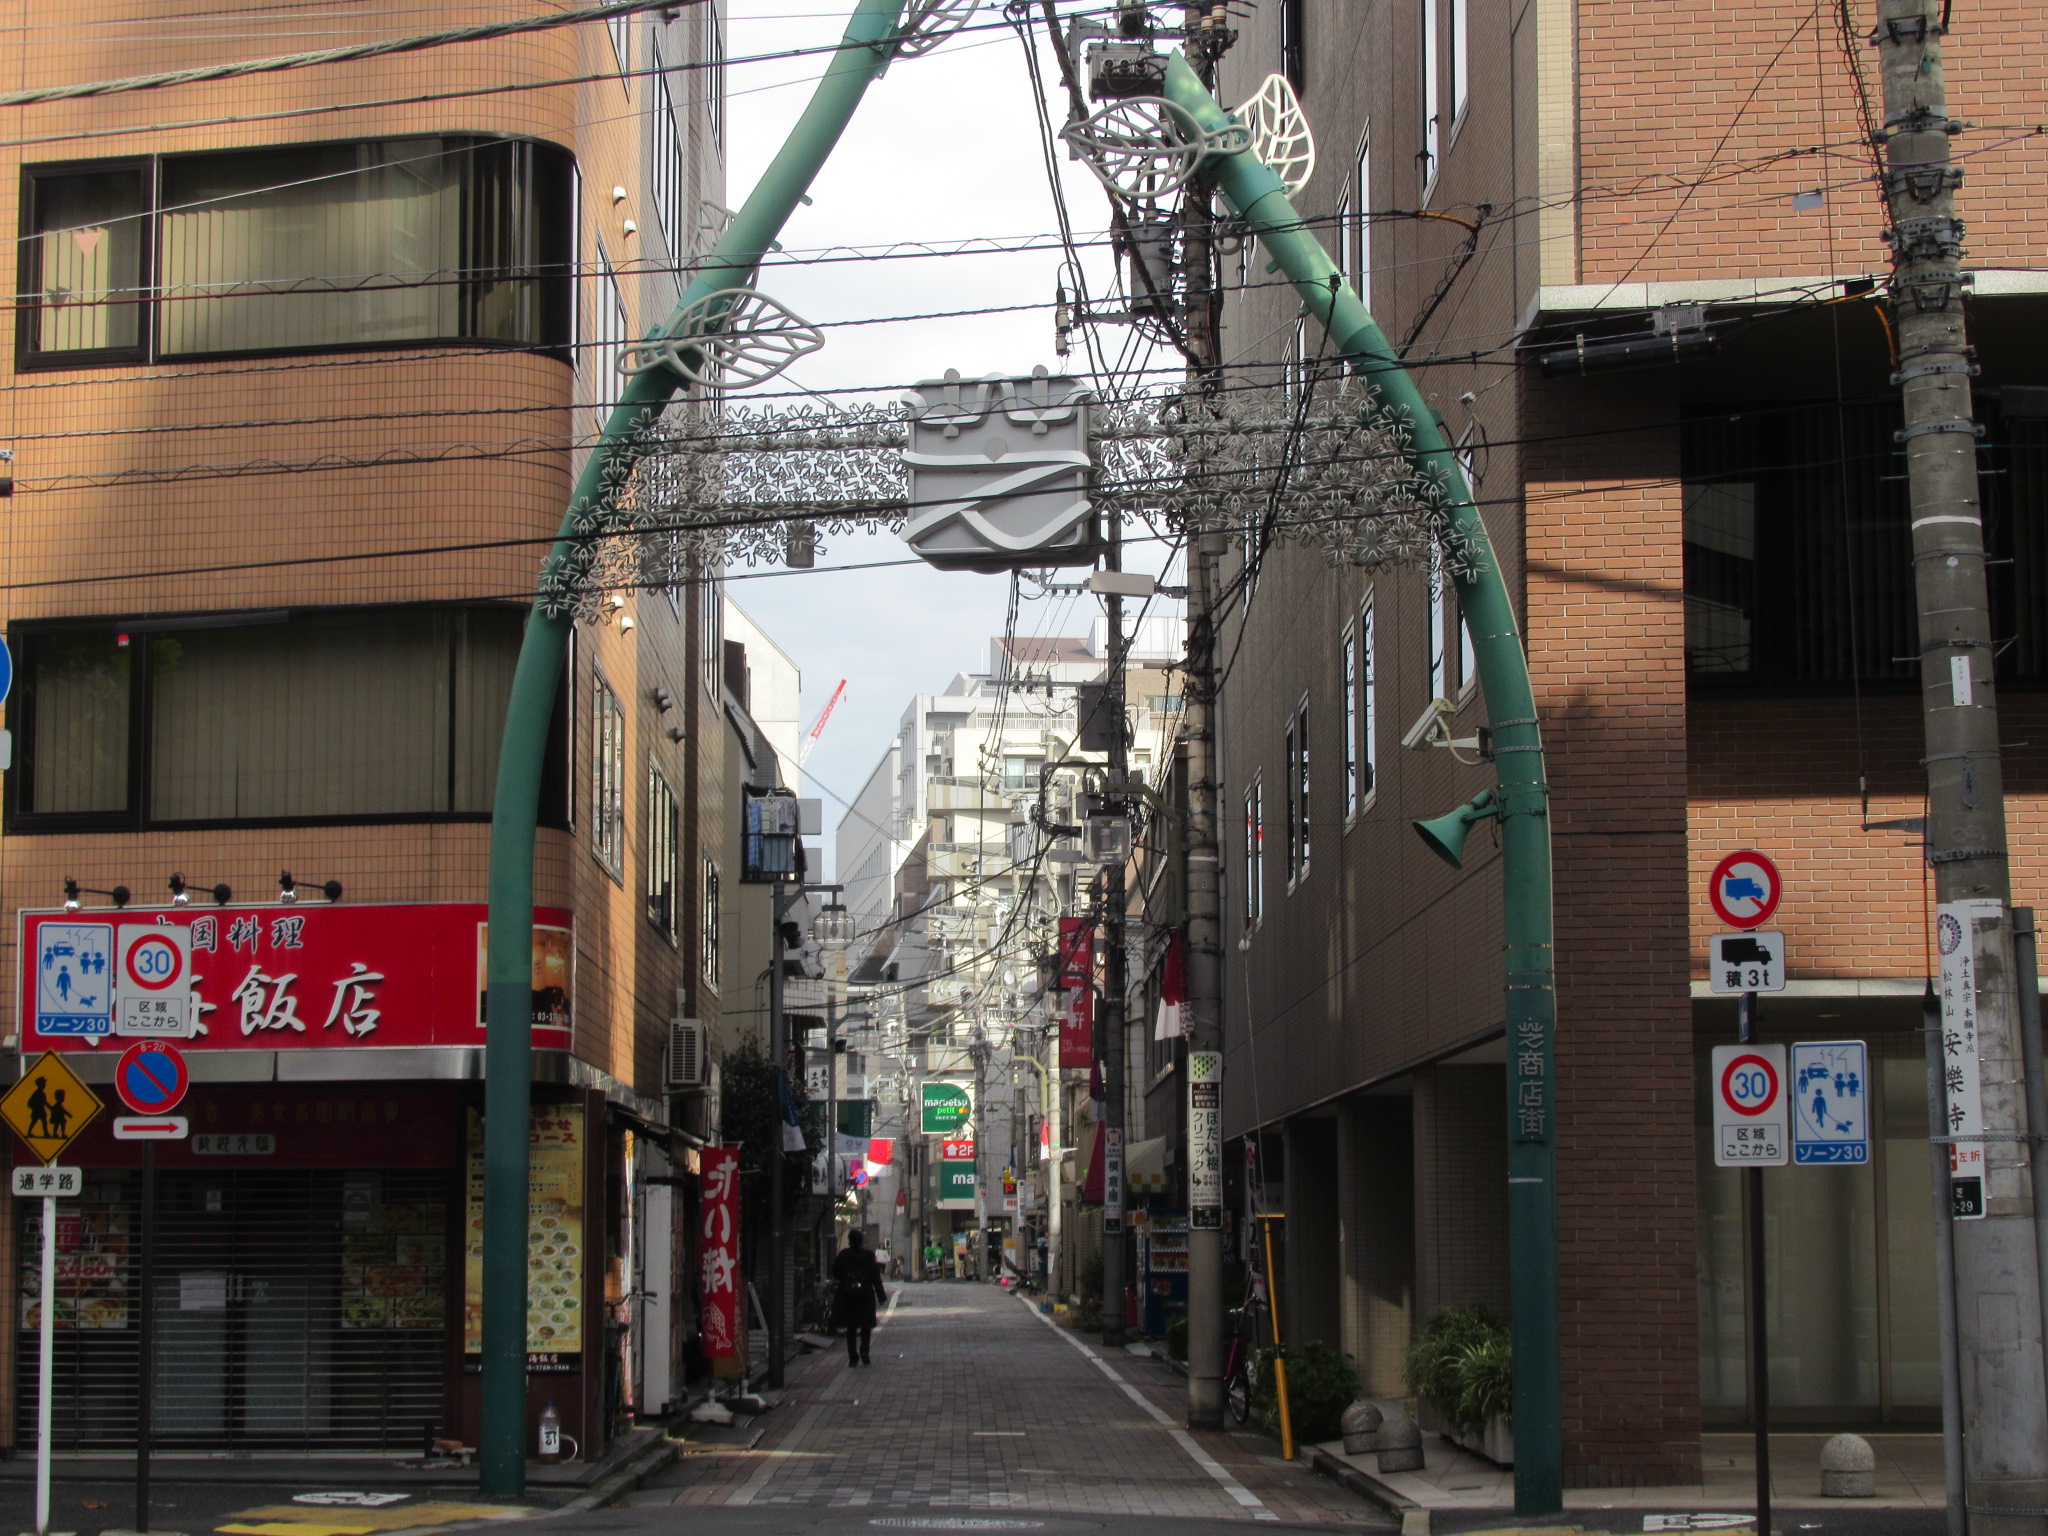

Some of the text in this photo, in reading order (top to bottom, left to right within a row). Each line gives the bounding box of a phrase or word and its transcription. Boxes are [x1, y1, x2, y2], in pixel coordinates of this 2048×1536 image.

[157, 915, 305, 953] 国料理
[139, 950, 170, 975] 30
[113, 963, 384, 1040] 飯店
[139, 1001, 168, 1013] 区域
[42, 1018, 106, 1032] ゾーン30
[127, 1016, 179, 1028] ここから
[140, 1043, 165, 1052] 8-20
[1518, 1022, 1545, 1135] 芝商店街
[1735, 1072, 1766, 1099] 30
[936, 1106, 955, 1115] petit
[1194, 1111, 1204, 1171] クリニック
[1737, 1128, 1765, 1141] 区域
[1726, 1142, 1777, 1157] ここから
[1800, 1145, 1864, 1160] ゾーン30
[1958, 1150, 1981, 1163] 左折
[19, 1173, 73, 1190] 通学路
[1005, 1184, 1015, 1194] P
[1953, 1200, 1973, 1213] -29
